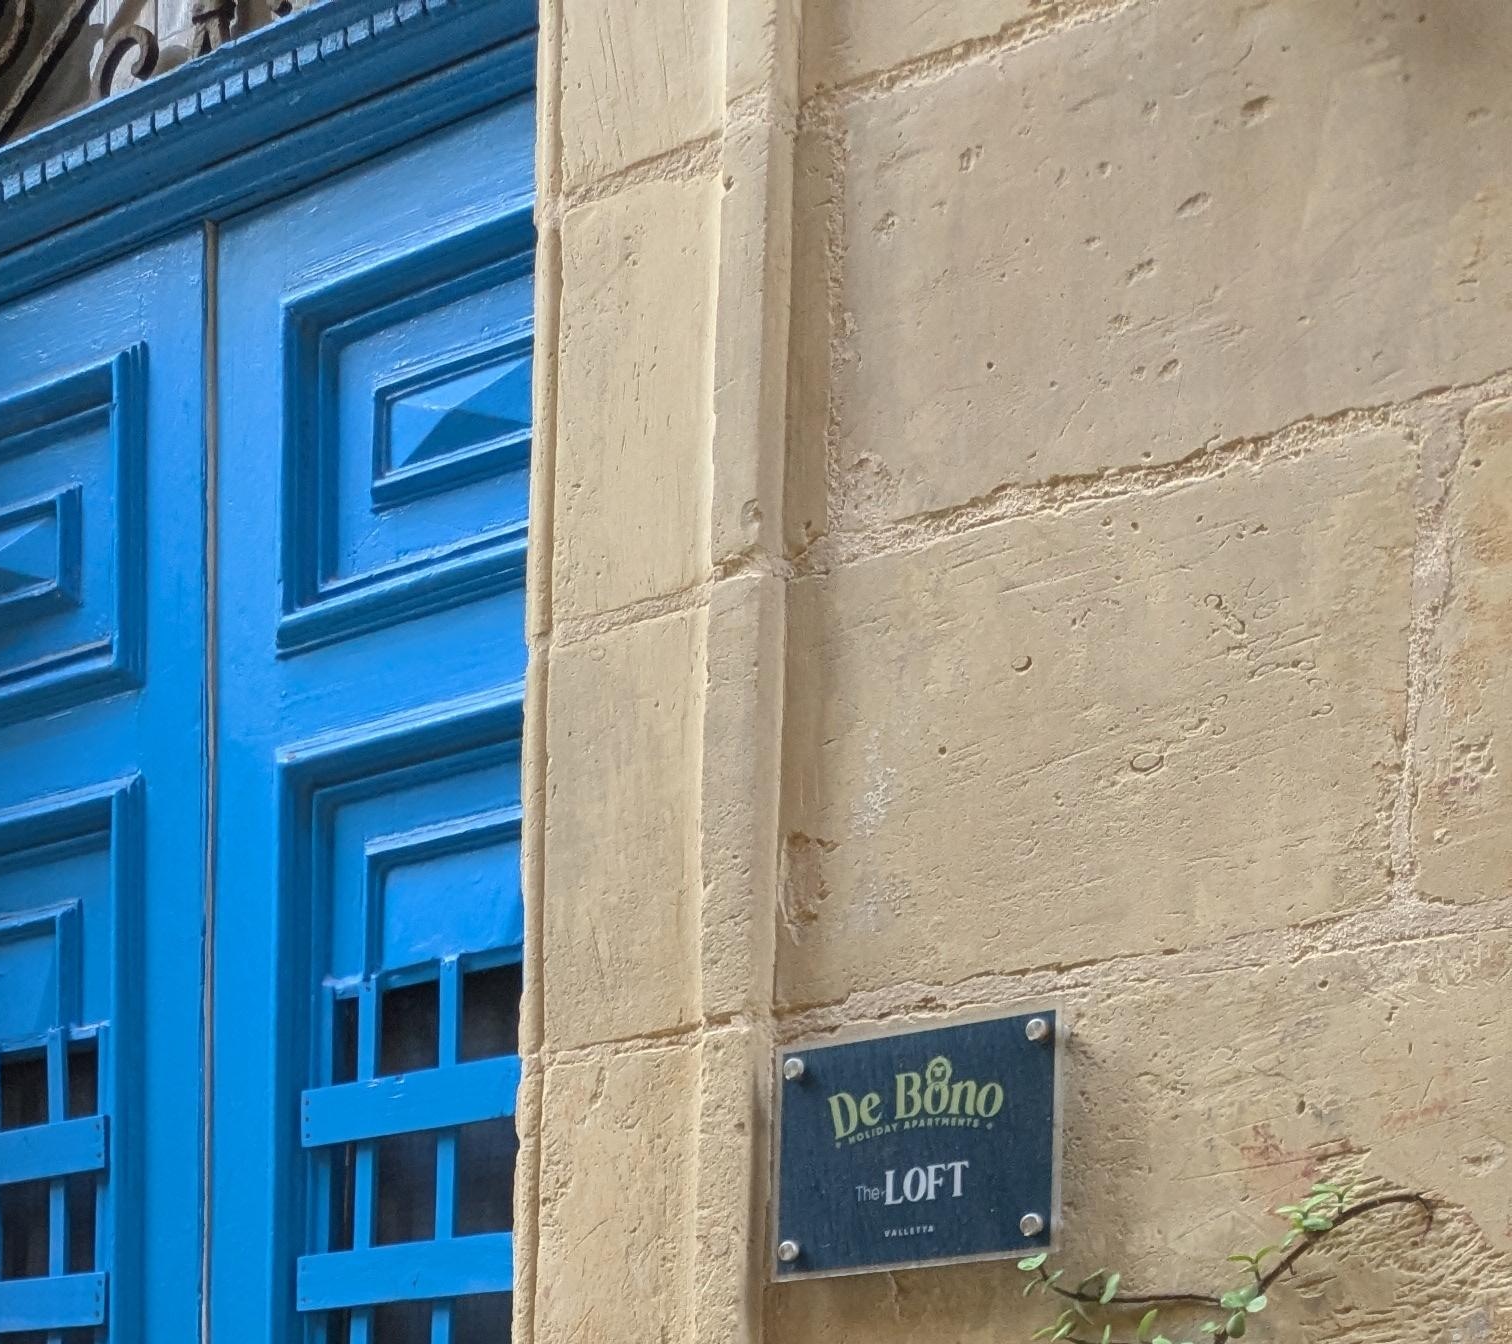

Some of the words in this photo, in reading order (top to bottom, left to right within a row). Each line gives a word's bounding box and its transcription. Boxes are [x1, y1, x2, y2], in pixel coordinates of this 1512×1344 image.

[828, 1091, 882, 1141] De
[894, 1071, 1005, 1121] Bono
[848, 1122, 899, 1145] HOLIDAY
[903, 1117, 980, 1130] APARTMENTS
[855, 1184, 881, 1202] The
[884, 1160, 970, 1206] LOFT
[884, 1225, 935, 1238] VALLETTA
